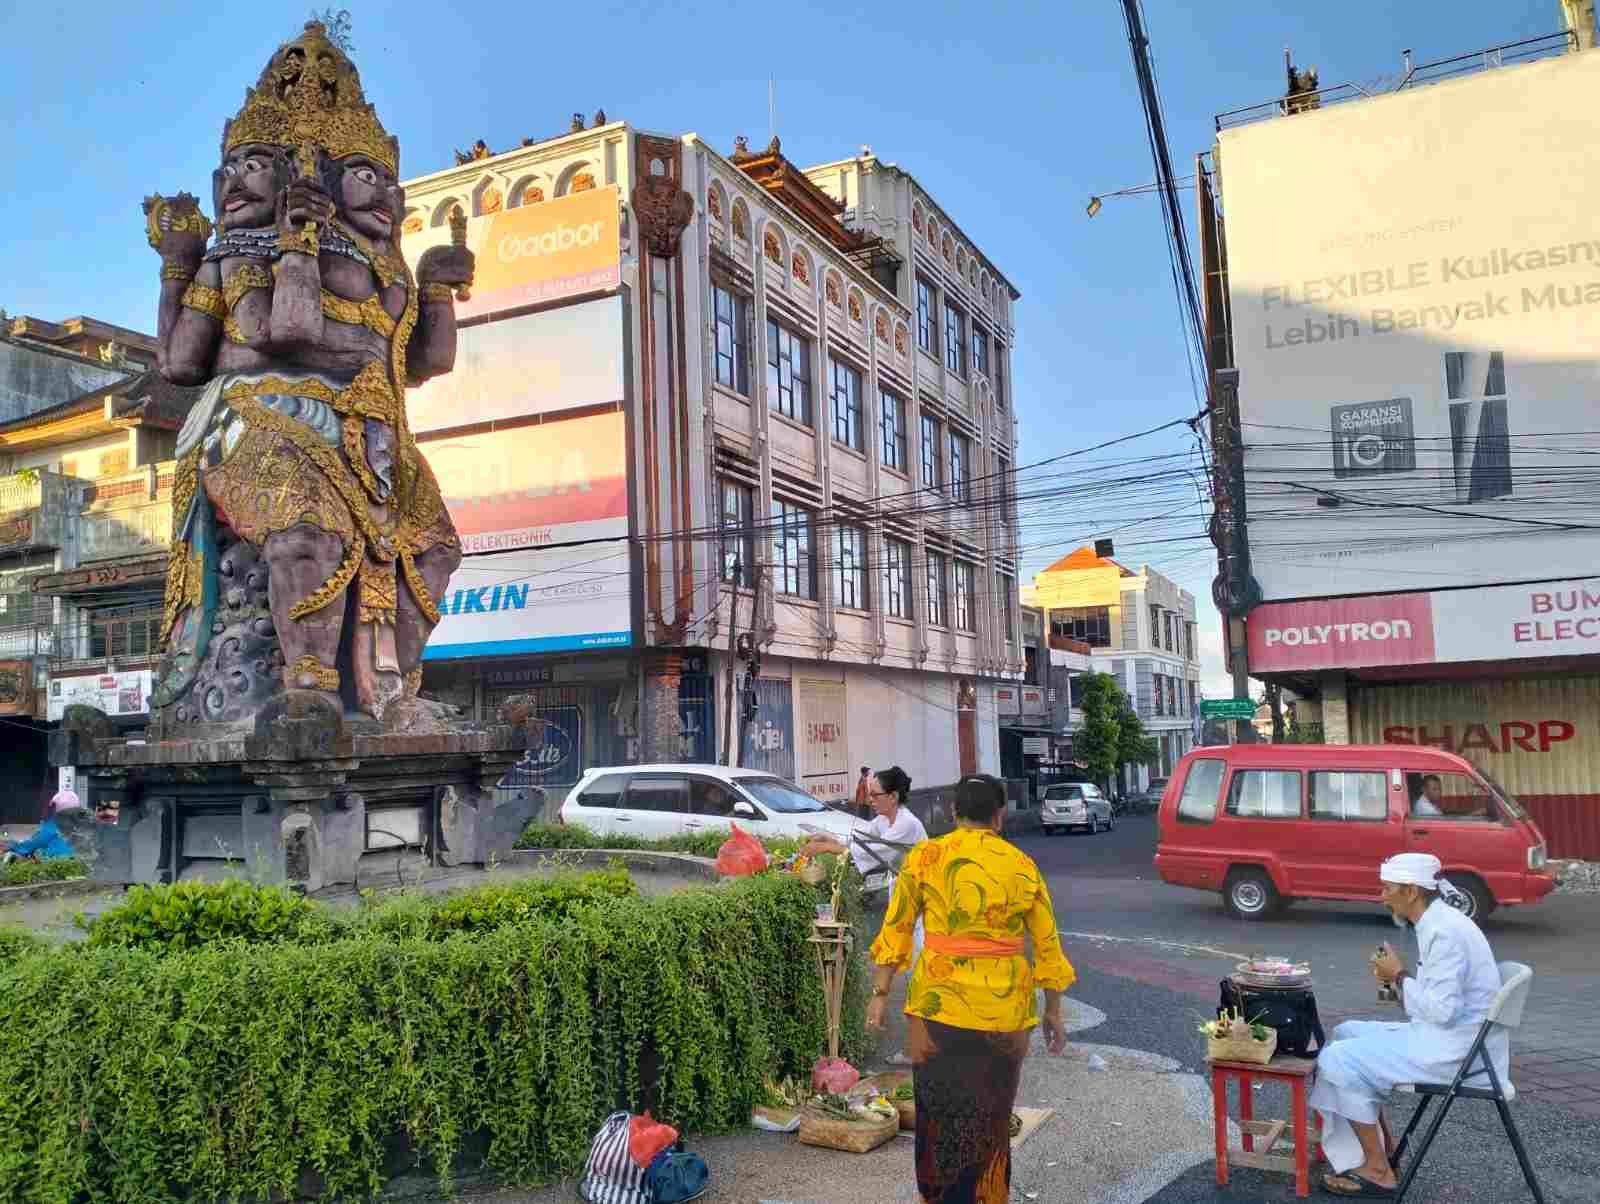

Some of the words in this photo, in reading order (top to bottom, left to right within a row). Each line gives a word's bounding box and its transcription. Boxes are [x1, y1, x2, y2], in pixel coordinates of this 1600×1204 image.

[1263, 261, 1432, 312] FLEXIBLE
[1264, 312, 1360, 350] Lebih
[1371, 289, 1511, 334] Banyak
[1340, 404, 1401, 422] GARANSI
[472, 527, 553, 551] ELEKTRONIK
[1513, 616, 1600, 643] ELEC
[1382, 719, 1576, 753] SHARP
